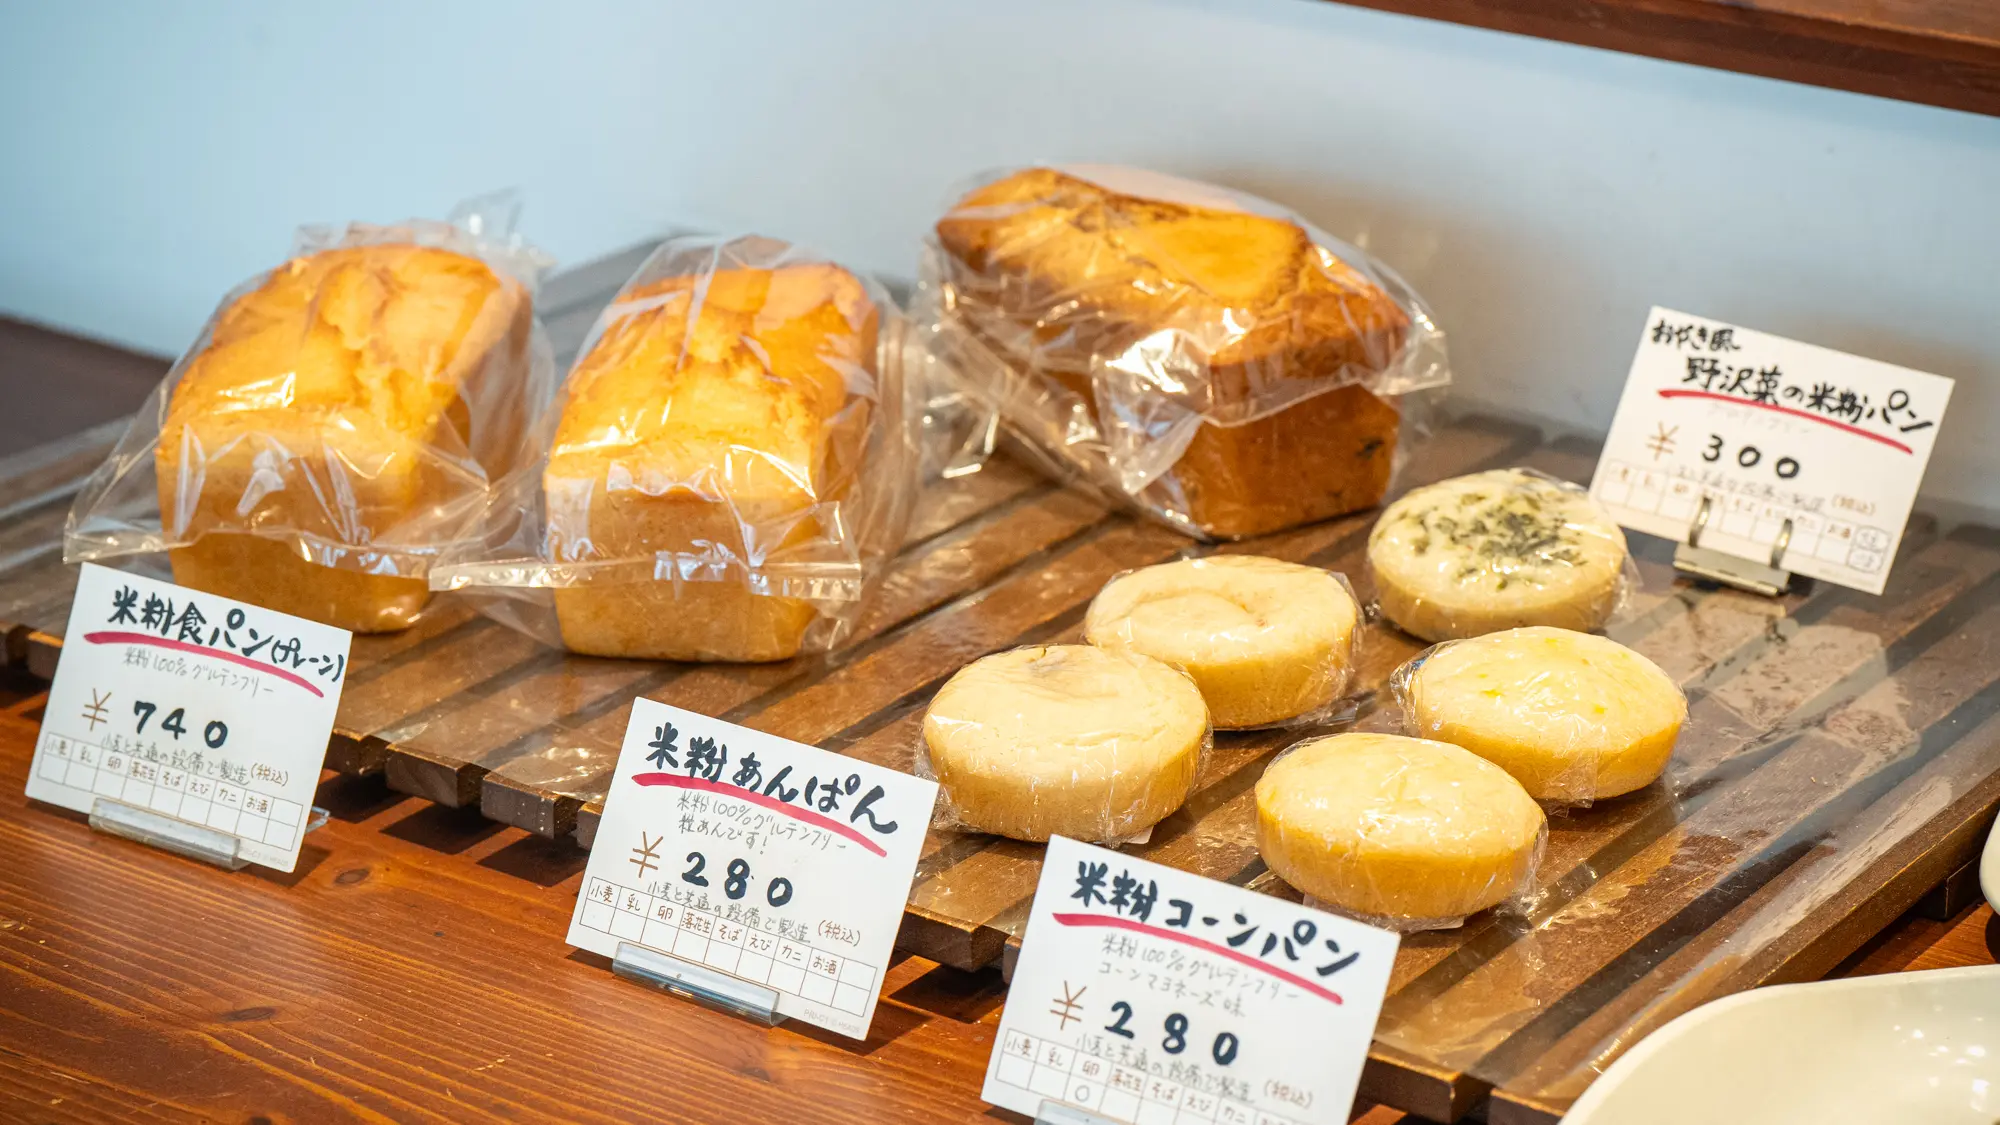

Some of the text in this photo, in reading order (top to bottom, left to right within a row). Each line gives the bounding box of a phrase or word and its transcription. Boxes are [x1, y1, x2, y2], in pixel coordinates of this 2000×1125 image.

[1682, 357, 1933, 433] 野沢菜の米粉パン
[1702, 434, 1800, 479] 300
[133, 701, 228, 748] 740
[645, 721, 899, 835] 米粉あんぱん
[681, 851, 794, 908] 280
[590, 886, 838, 976] 小麦 乳 卵 落花生 そば えび カニ お酒
[818, 919, 861, 947] (税込)
[1070, 860, 1360, 977] 米粉コーンパン
[1104, 1001, 1239, 1066] 280
